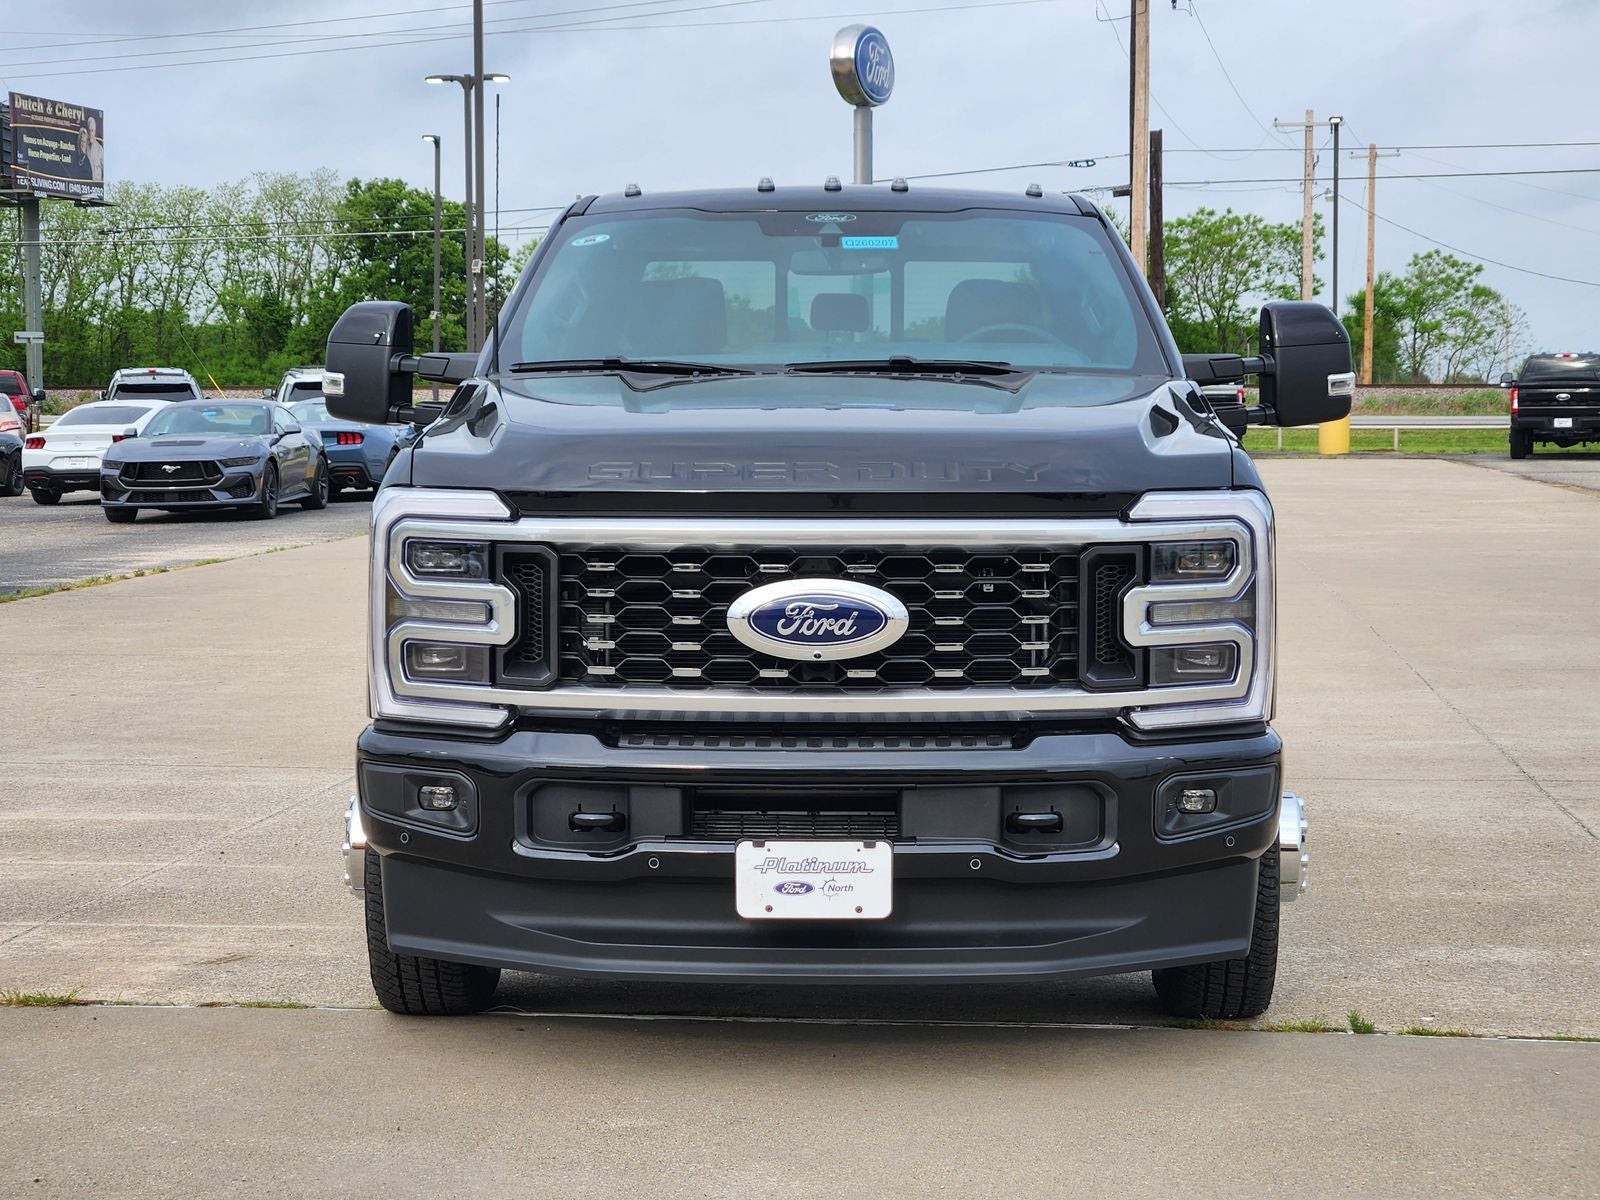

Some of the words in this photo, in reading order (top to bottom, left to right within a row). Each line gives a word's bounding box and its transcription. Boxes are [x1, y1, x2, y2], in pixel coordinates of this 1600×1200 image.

[866, 41, 890, 90] Ford
[14, 94, 44, 113] Dutch
[46, 101, 53, 115] &
[55, 102, 85, 124] Cheryl
[62, 154, 72, 163] Land
[814, 213, 848, 222] Ford
[586, 460, 840, 482] SUPER
[857, 460, 1050, 482] DUTY
[776, 601, 859, 636] Ford
[753, 857, 874, 874] Platinum
[781, 881, 807, 894] Ford
[827, 884, 853, 892] North
